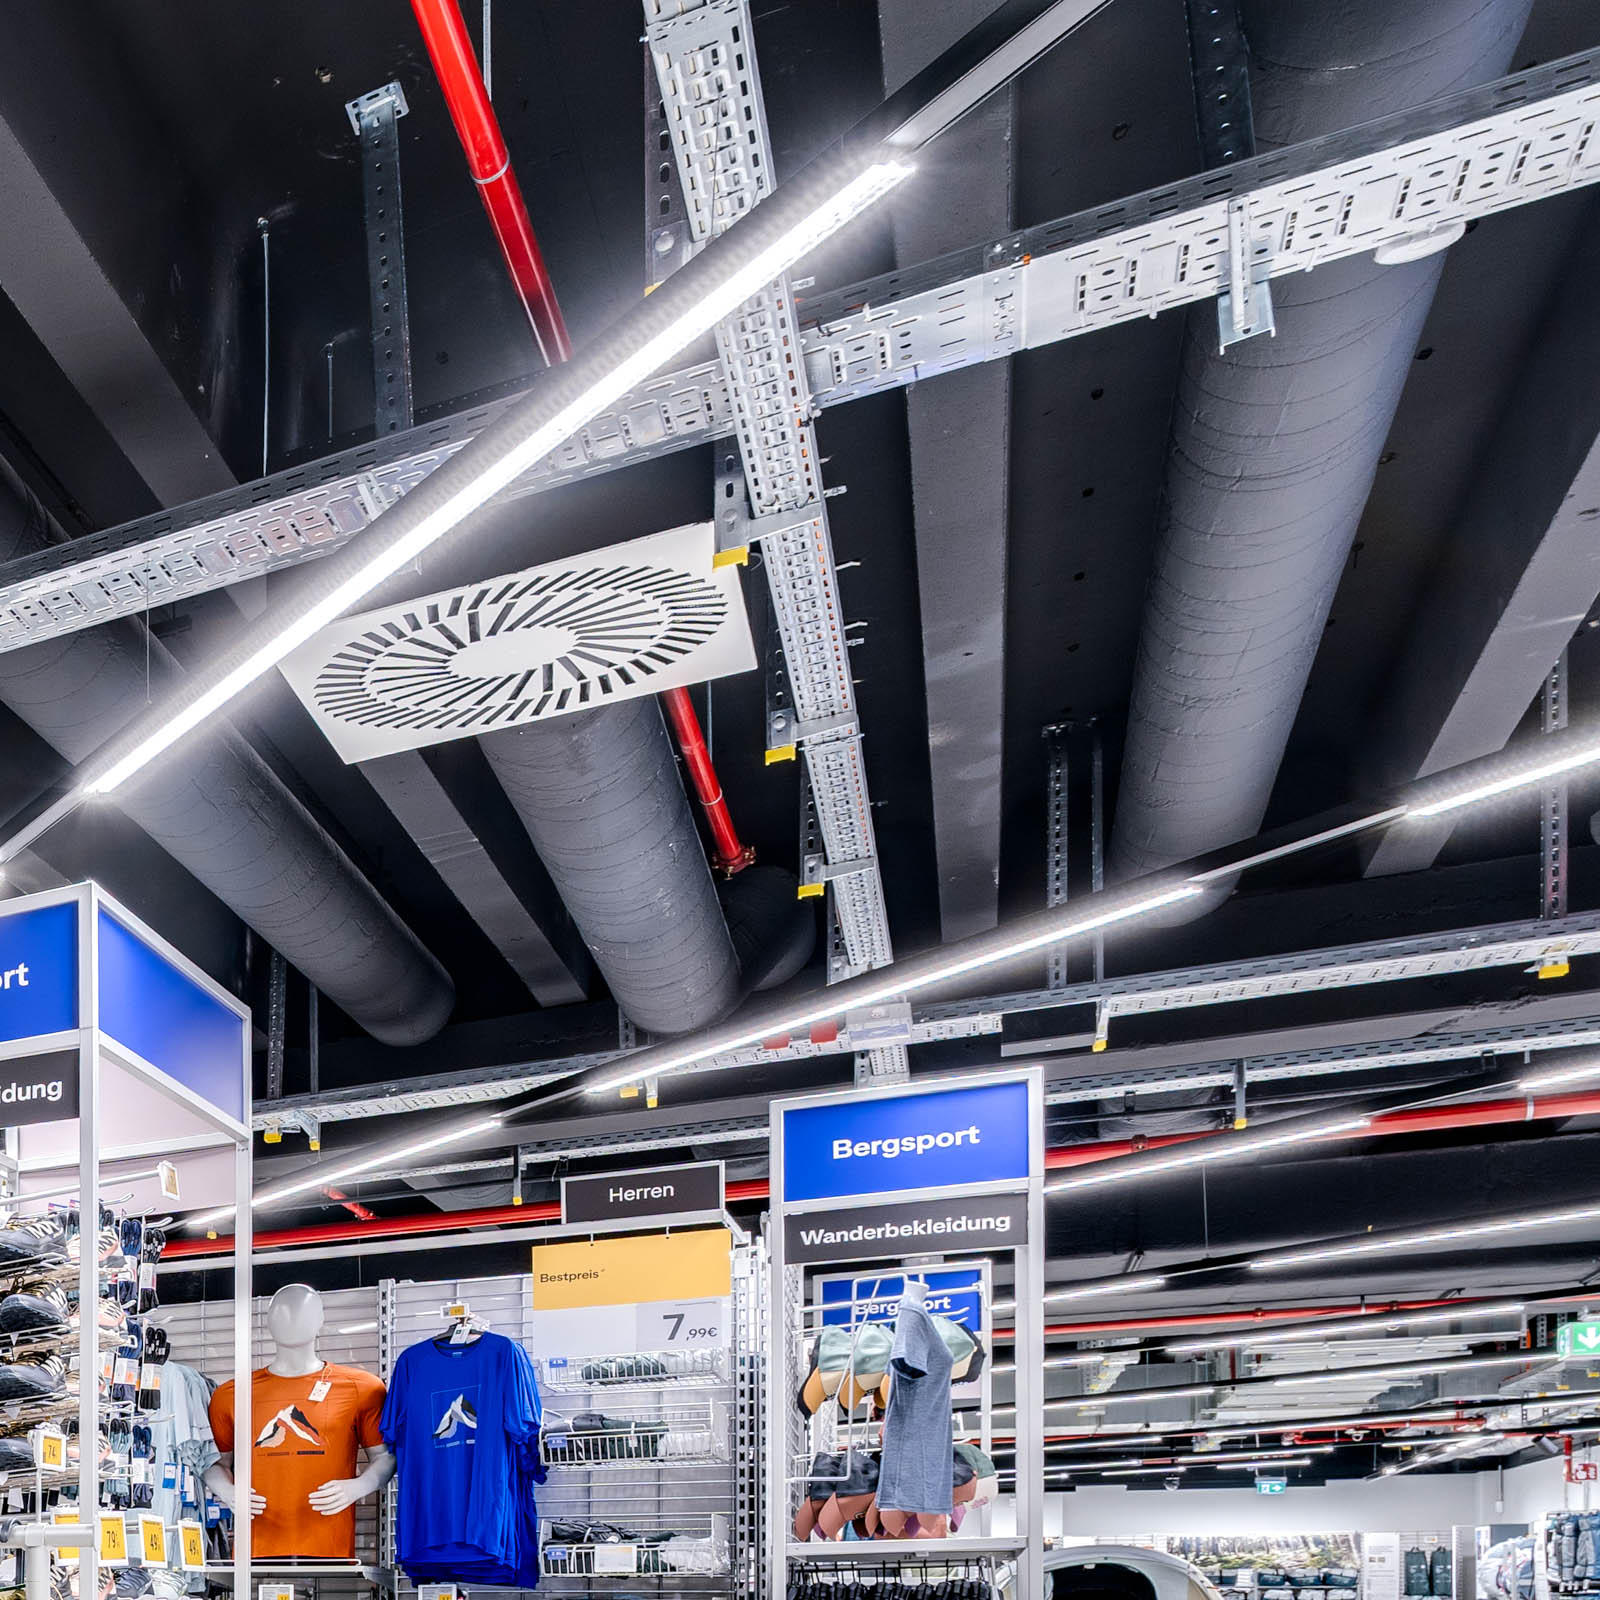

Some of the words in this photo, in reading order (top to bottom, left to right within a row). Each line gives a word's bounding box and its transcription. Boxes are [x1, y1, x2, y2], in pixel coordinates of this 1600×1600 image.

[832, 1126, 981, 1160] Bergsport
[609, 1184, 675, 1203] Herren
[800, 1215, 1011, 1246] Wanderbekleidung
[540, 1269, 599, 1283] Bestpreis
[663, 1313, 718, 1341] 7,99€
